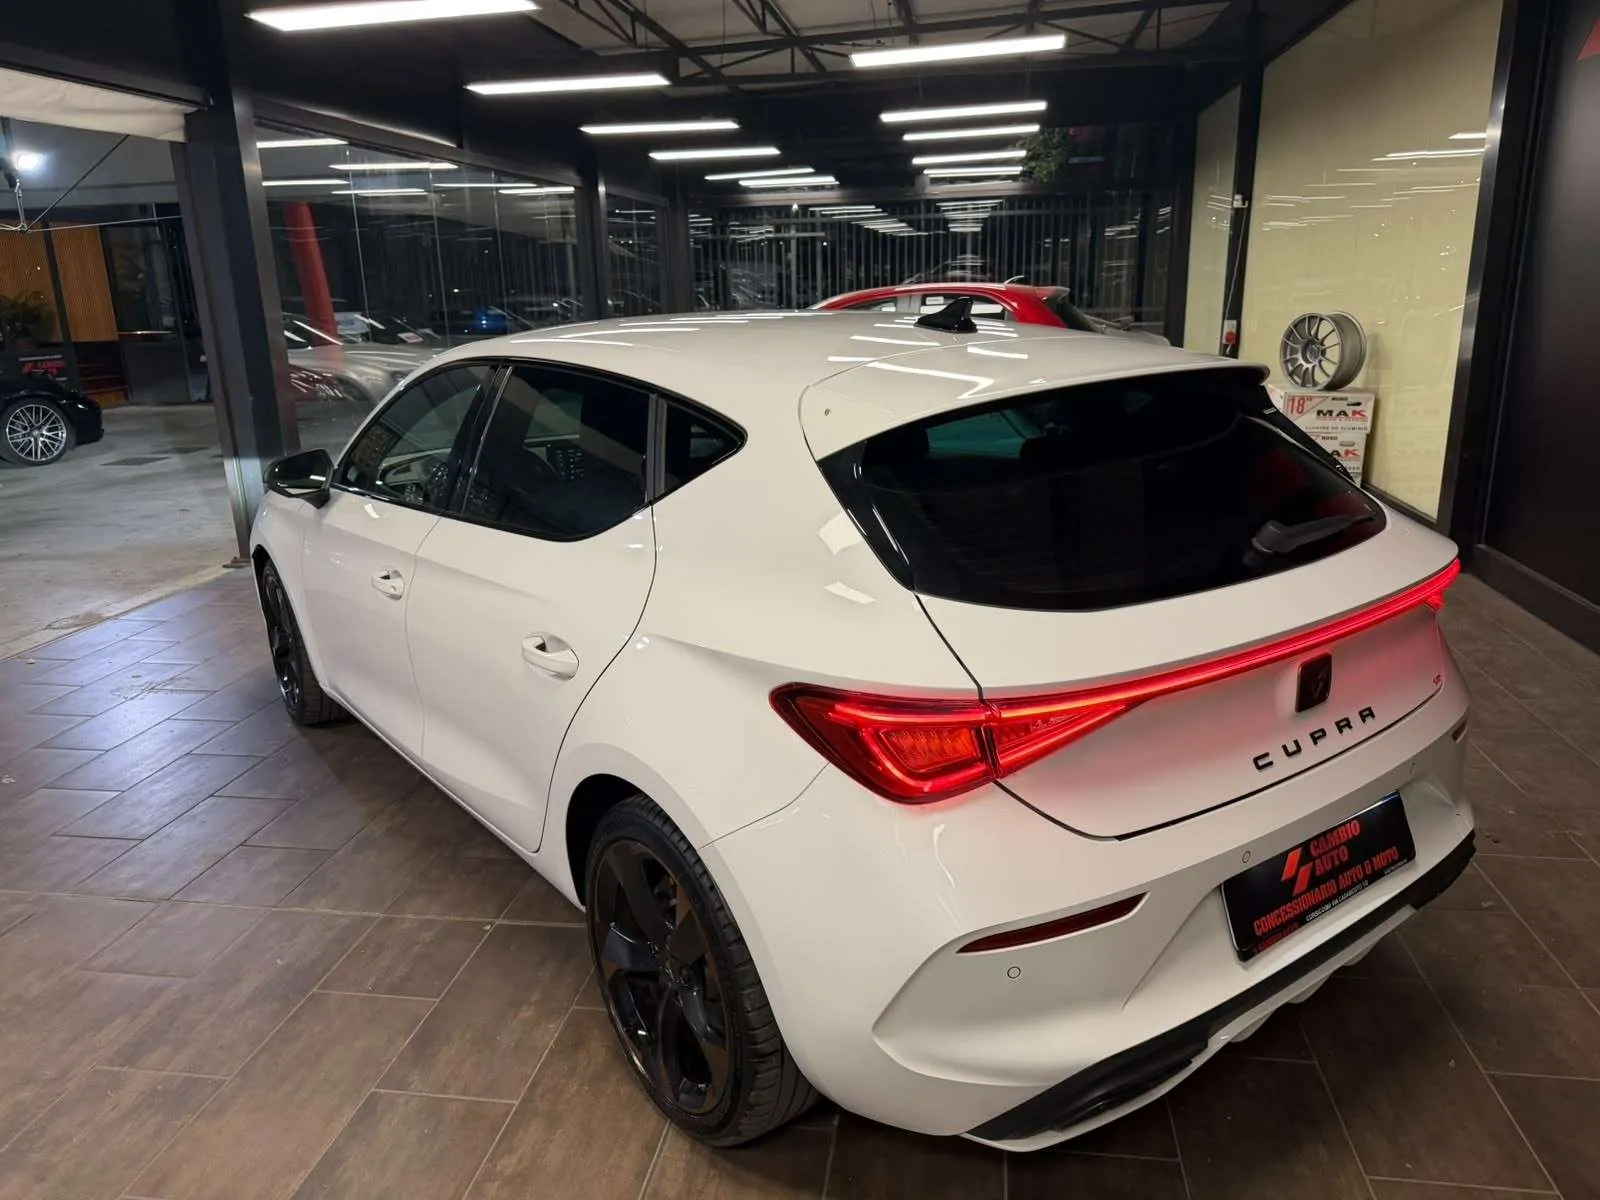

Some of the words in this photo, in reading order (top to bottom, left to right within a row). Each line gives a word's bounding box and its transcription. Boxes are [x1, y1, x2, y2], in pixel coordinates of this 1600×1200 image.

[1316, 409, 1367, 417] MAK
[1252, 706, 1376, 771] CUPRA
[1310, 820, 1361, 857] CAMBIO
[1315, 845, 1349, 876] AUTO
[1253, 879, 1337, 936] CONCESSIONARIO
[1338, 863, 1364, 890] AUTO
[1372, 846, 1399, 871] MOTO
